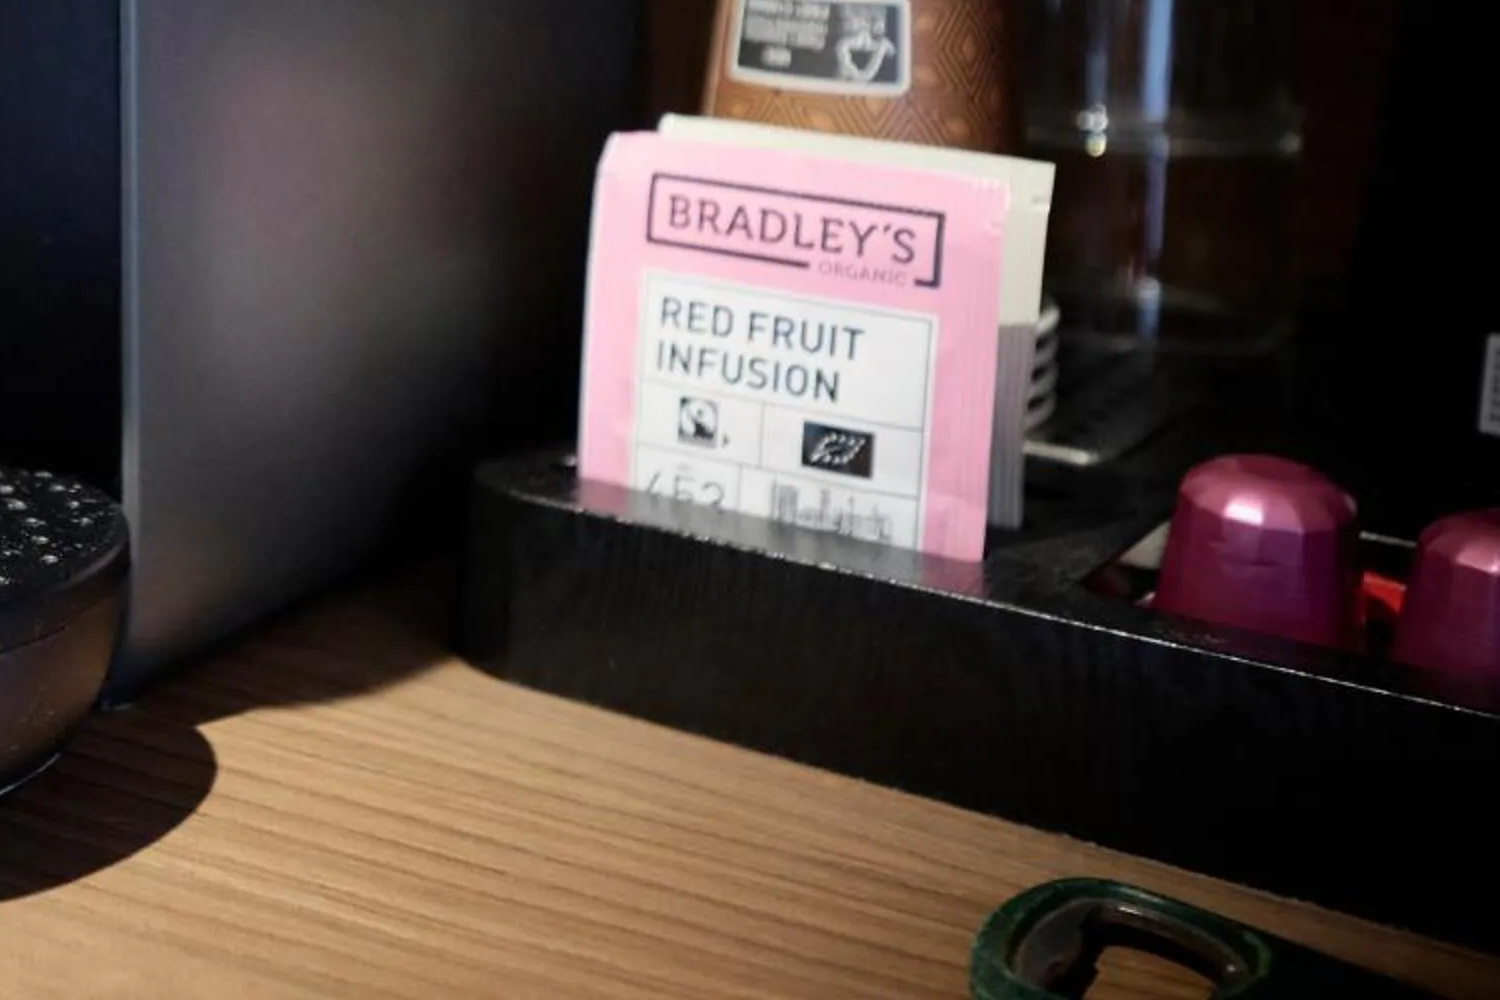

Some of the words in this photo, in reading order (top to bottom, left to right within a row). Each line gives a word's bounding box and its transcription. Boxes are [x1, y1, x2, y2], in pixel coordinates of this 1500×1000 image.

[668, 194, 917, 264] BRADLEY'S
[818, 261, 908, 286] ORGANIC
[660, 297, 735, 338] RED
[747, 311, 866, 360] FRUIT
[656, 340, 840, 404] INFUSION
